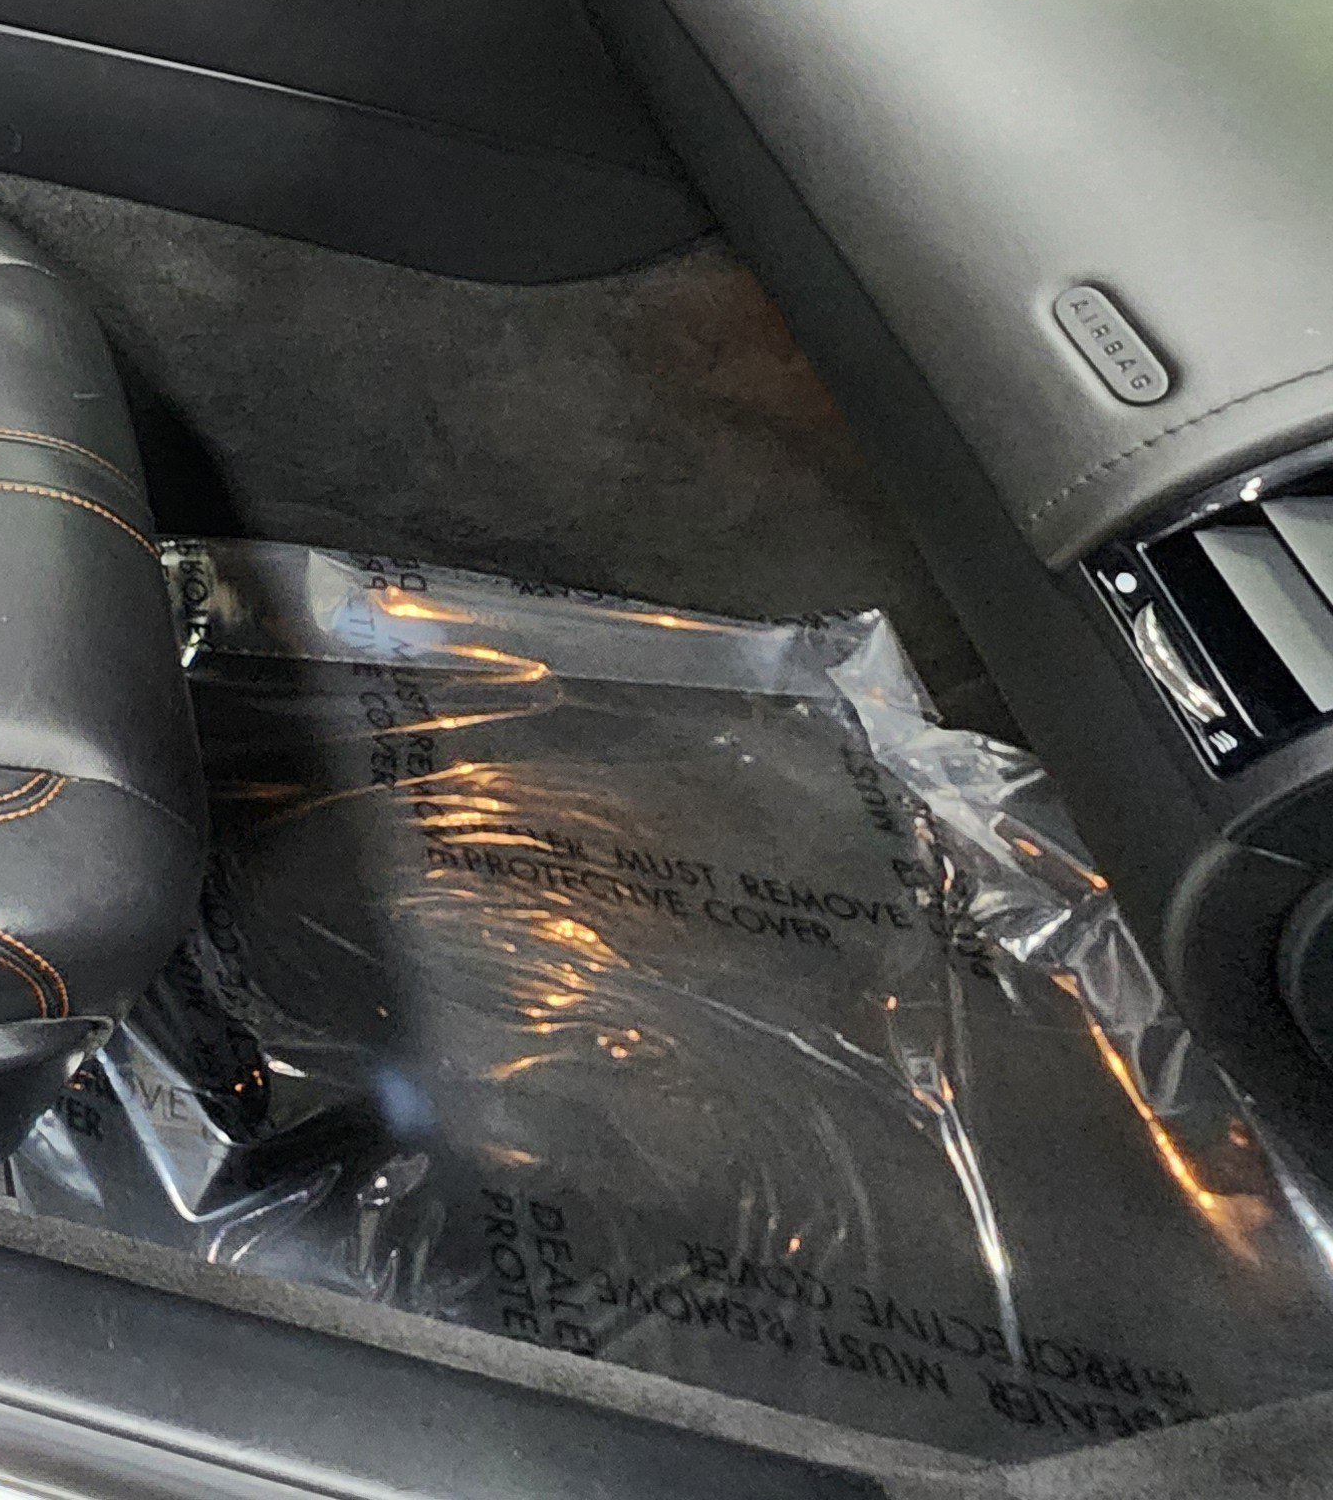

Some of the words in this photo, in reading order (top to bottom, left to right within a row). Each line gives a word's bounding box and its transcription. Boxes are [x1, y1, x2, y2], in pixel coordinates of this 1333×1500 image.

[1070, 298, 1151, 392] AIRBAG
[463, 846, 692, 917] PROTECTIVE
[704, 898, 836, 950] COVER
[614, 843, 718, 890] MUST
[739, 870, 913, 930] REMOVE
